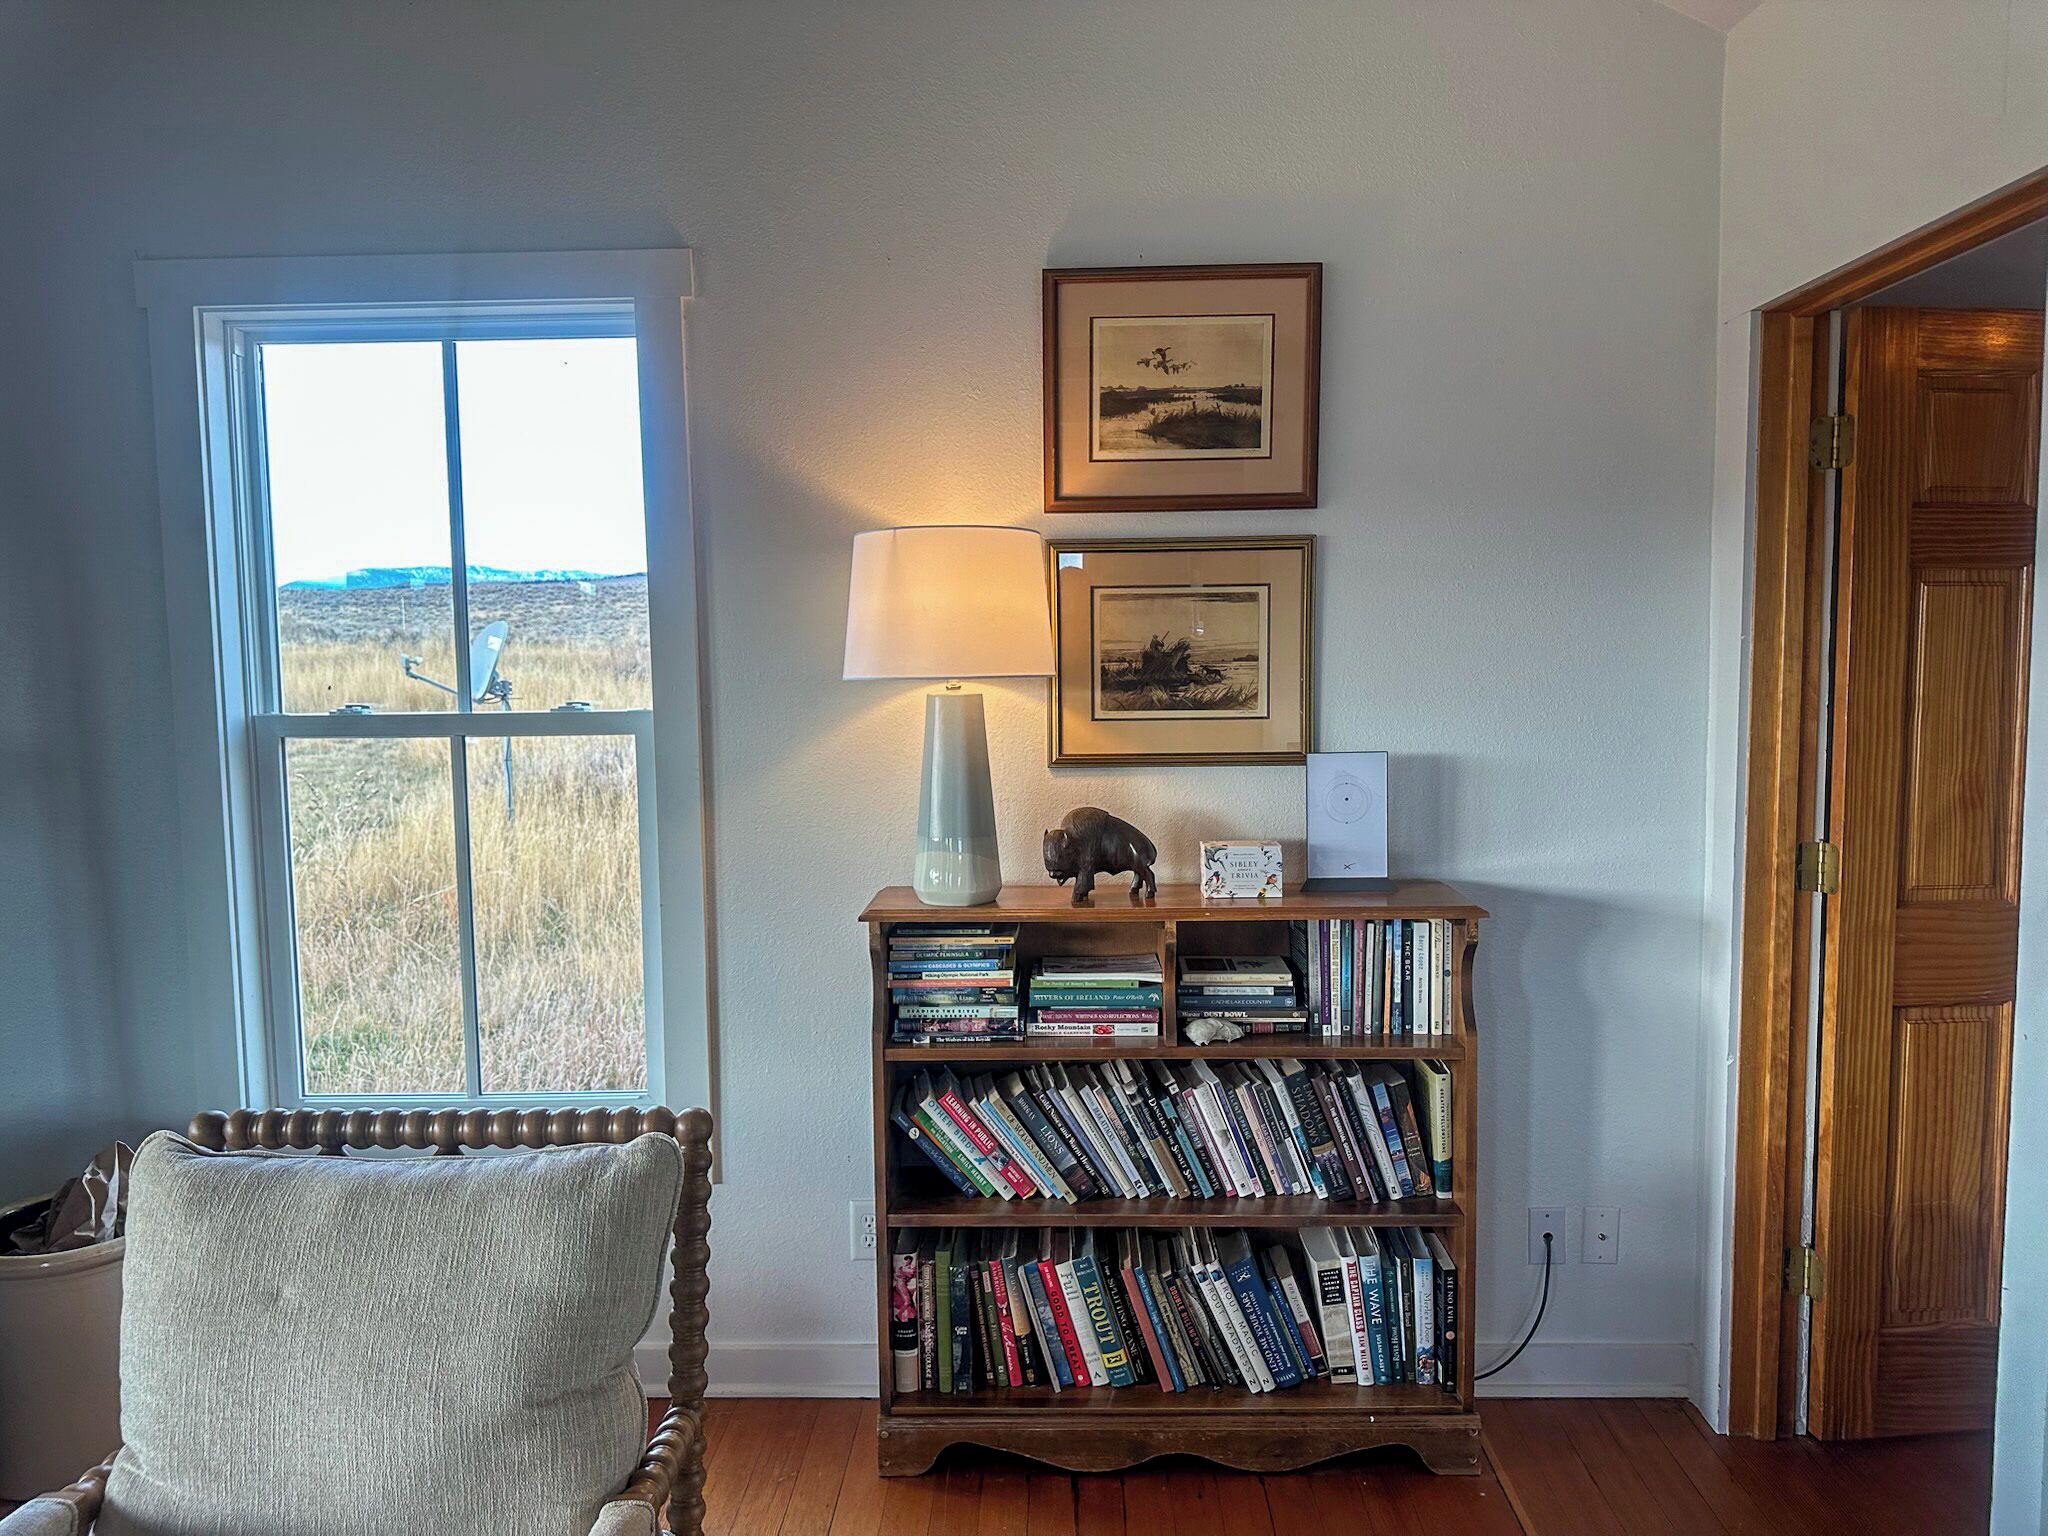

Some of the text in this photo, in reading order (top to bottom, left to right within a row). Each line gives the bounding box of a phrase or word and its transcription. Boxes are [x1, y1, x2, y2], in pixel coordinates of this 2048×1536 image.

[927, 1098, 977, 1154] OTHER BIRDS
[945, 1094, 994, 1149] LEARNING IN PUBLIC
[1017, 1096, 1065, 1155] MORGAN LIONS
[1099, 1118, 1116, 1141] ATTACKS
[1124, 1103, 1140, 1129] John Colter
[1149, 1121, 1160, 1137] Bear
[1227, 1090, 1241, 1113] SILENT
[1237, 1115, 1251, 1140] SPRING
[1290, 1085, 1320, 1144] SHADOWS
[1302, 1082, 1327, 1130] EMPIRE
[1337, 1075, 1364, 1138] KINGS YUKON
[1005, 1113, 1057, 1179] OF WOLVES AND MEN
[1038, 1093, 1052, 1110] Cold
[1059, 1125, 1071, 1138] and
[1068, 1137, 1083, 1156] Warm
[1079, 1154, 1097, 1176] Hearts
[1148, 1097, 1169, 1129] DANCERS
[1170, 1143, 1188, 1168] SUNSET
[1183, 1167, 1194, 1182] SKY
[1260, 1123, 1276, 1155] BEAR STORIES
[1329, 1107, 1354, 1161] THE ESSENTIAL GRIZZLY
[957, 1153, 987, 1185] EMILY HENRY
[991, 1265, 1000, 1296] AMBROSE
[1060, 1271, 1079, 1301] Full
[1348, 1265, 1356, 1278] THE
[1349, 1280, 1361, 1306] CAPTAIN
[1364, 1262, 1377, 1284] THE
[1082, 1281, 1115, 1346] TROUT
[1107, 1277, 1138, 1357] SPLITTING CANE
[1168, 1285, 1185, 1311] DOUBLE
[1219, 1279, 1259, 1357] TROUT MAGIC
[1353, 1308, 1364, 1329] CLASS
[1368, 1289, 1382, 1324] WAVE
[1423, 1292, 1432, 1343] Merle's Door
[1447, 1291, 1452, 1303] NO
[1050, 1289, 1064, 1318] GOOD
[1060, 1321, 1069, 1334] TO
[1065, 1338, 1081, 1371] GREAT
[1204, 1281, 1252, 1373] TROUT MADNESS
[1239, 1291, 1279, 1372] LEND ME YOUR EARS
[1248, 1290, 1285, 1369] GREAT SPEECHES IN HISTORY
[1375, 1334, 1383, 1352] SUSAN
